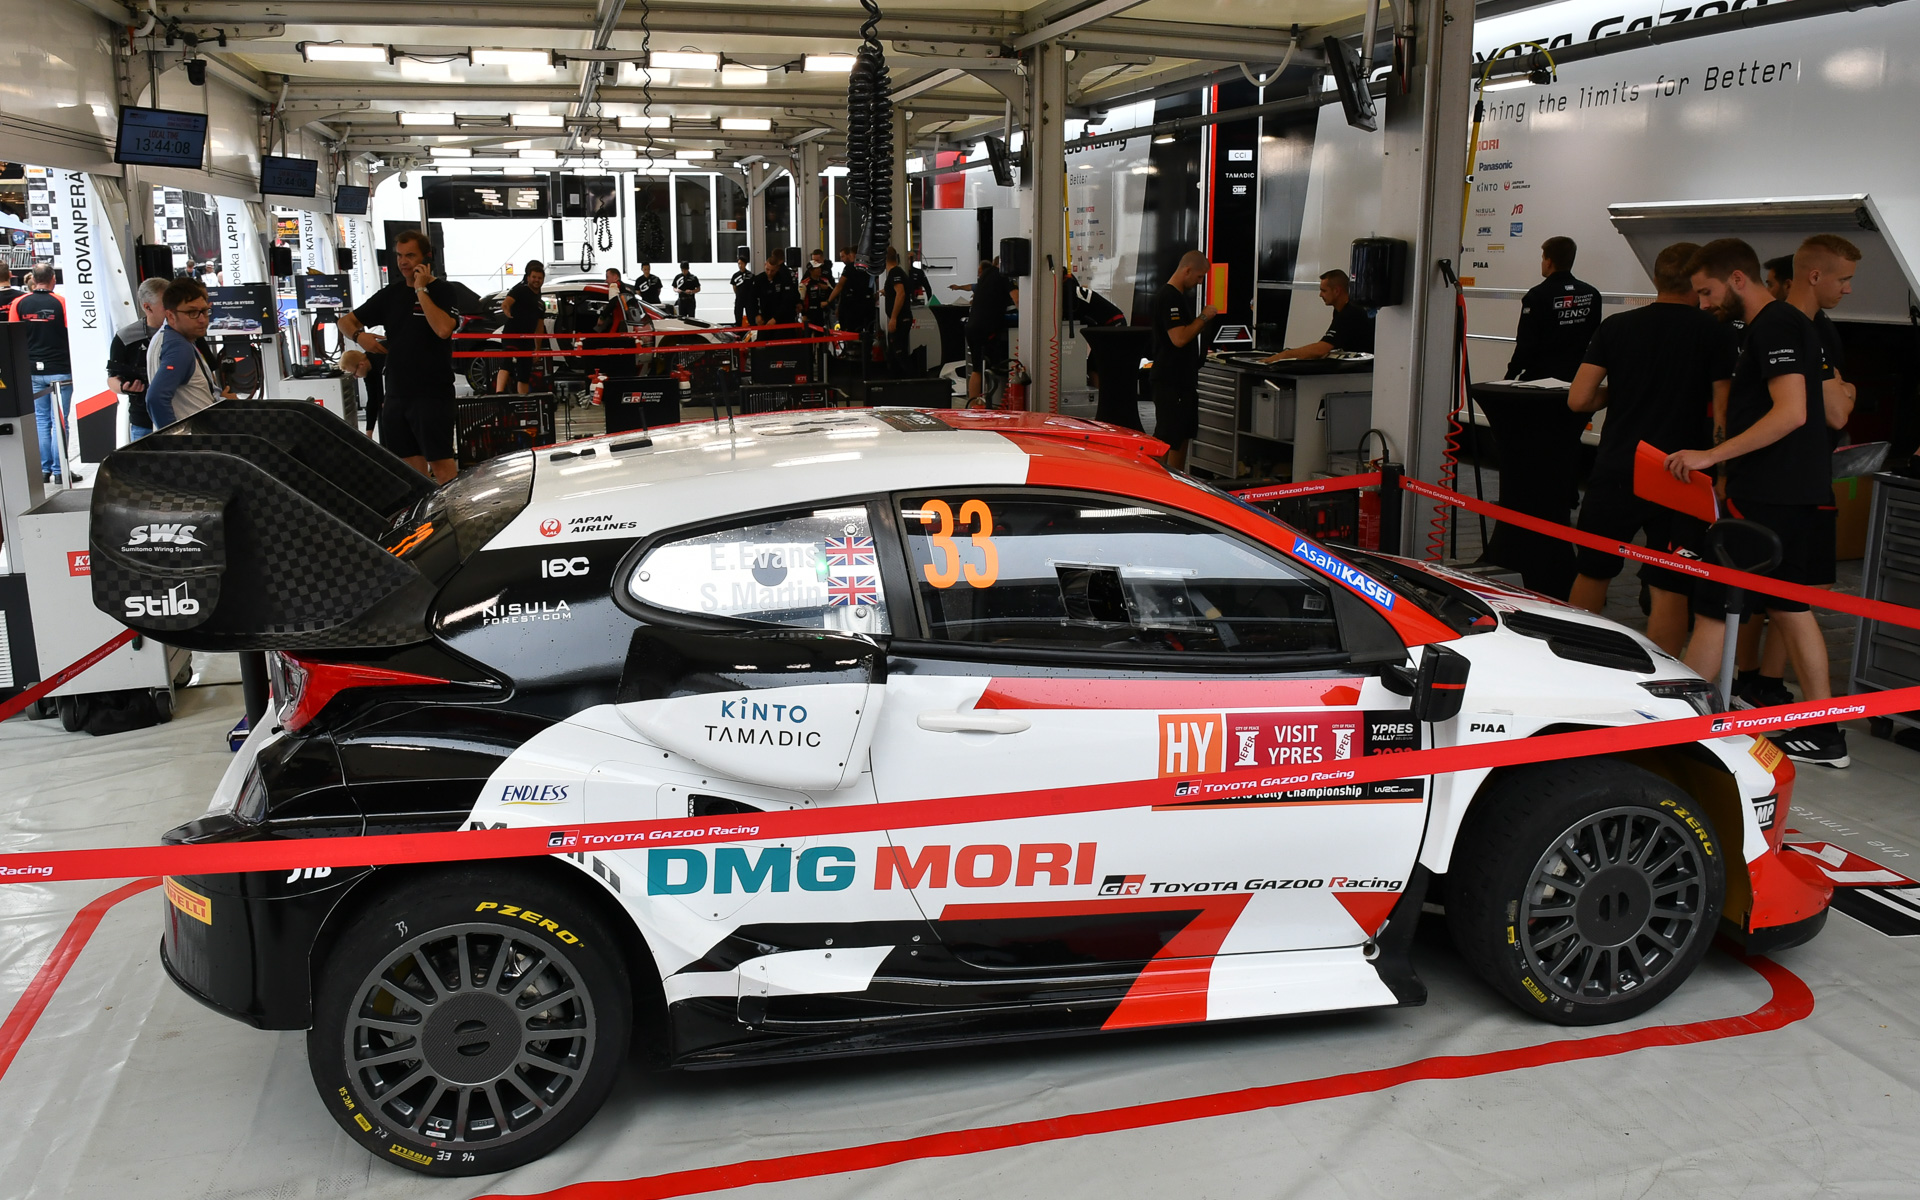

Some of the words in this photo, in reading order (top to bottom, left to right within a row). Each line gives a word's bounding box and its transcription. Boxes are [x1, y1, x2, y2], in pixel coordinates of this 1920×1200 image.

[1538, 94, 1567, 115] the
[1579, 85, 1639, 109] limits
[1655, 74, 1690, 99] for
[1703, 59, 1793, 91] Better
[149, 129, 165, 139] LOCAL
[167, 131, 180, 140] TIME
[136, 137, 191, 155] 13:44:08
[1478, 160, 1513, 171] Panasonic
[1232, 186, 1247, 194] OMP
[64, 172, 94, 284] ROVANPERÄ
[227, 213, 239, 249] LAPPI
[1472, 261, 1489, 269] PIAA
[80, 290, 98, 329] Kalle
[1554, 300, 1573, 308] GR
[1558, 307, 1591, 318] DENSO
[1252, 491, 1278, 499] TOYOTA
[1279, 487, 1303, 496] GAZOO
[1303, 485, 1325, 493] Racing
[1415, 485, 1433, 494] TOYOTA
[1432, 491, 1450, 500] GAZOO
[1450, 495, 1466, 507] Racing
[568, 514, 613, 525] JAPAN
[571, 521, 637, 534] AIRLINES
[127, 523, 200, 546] SWS
[920, 499, 999, 589] 33
[710, 541, 820, 571] E.Evans
[1631, 550, 1658, 562] TOYOTA
[1659, 558, 1684, 569] GAZOO
[1685, 564, 1710, 577] Racing
[125, 581, 200, 618] Stilo
[700, 580, 822, 612] S.Martin
[482, 599, 571, 618] NISULA
[1371, 723, 1414, 734] YPRES
[1469, 722, 1506, 733] PIAA
[1711, 722, 1733, 732] GR
[1736, 716, 1783, 728] TOYOTA
[1783, 710, 1826, 722] GAZOO
[1827, 705, 1866, 717] Racing
[704, 725, 822, 748] TAMADIC
[1274, 724, 1319, 743] VISIT
[1166, 721, 1214, 774] HY
[1239, 735, 1255, 761] IEPER
[1268, 746, 1324, 765] YPRES
[1336, 733, 1351, 760] IEPER
[501, 784, 570, 802] ENDLESS
[1175, 786, 1200, 796] GR
[1204, 781, 1257, 793] TOYOTA
[1260, 775, 1308, 787] GAZOO
[1310, 770, 1355, 783] Racing
[1789, 805, 1859, 837] limits
[548, 835, 578, 847] GR
[582, 832, 645, 845] TOYOTA
[648, 828, 705, 840] GAZOO
[708, 825, 760, 837] Racing
[1867, 840, 1910, 858] the
[0, 864, 54, 877] Racing
[647, 845, 857, 896] DMG
[874, 841, 1098, 891] MORI
[1100, 882, 1141, 895] GR
[1149, 881, 1238, 894] TOYOTA
[1244, 878, 1324, 891] GAZOO
[1328, 876, 1403, 892] Racing
[165, 879, 207, 919] PIRELLI
[389, 1143, 433, 1166] PIRELLI
